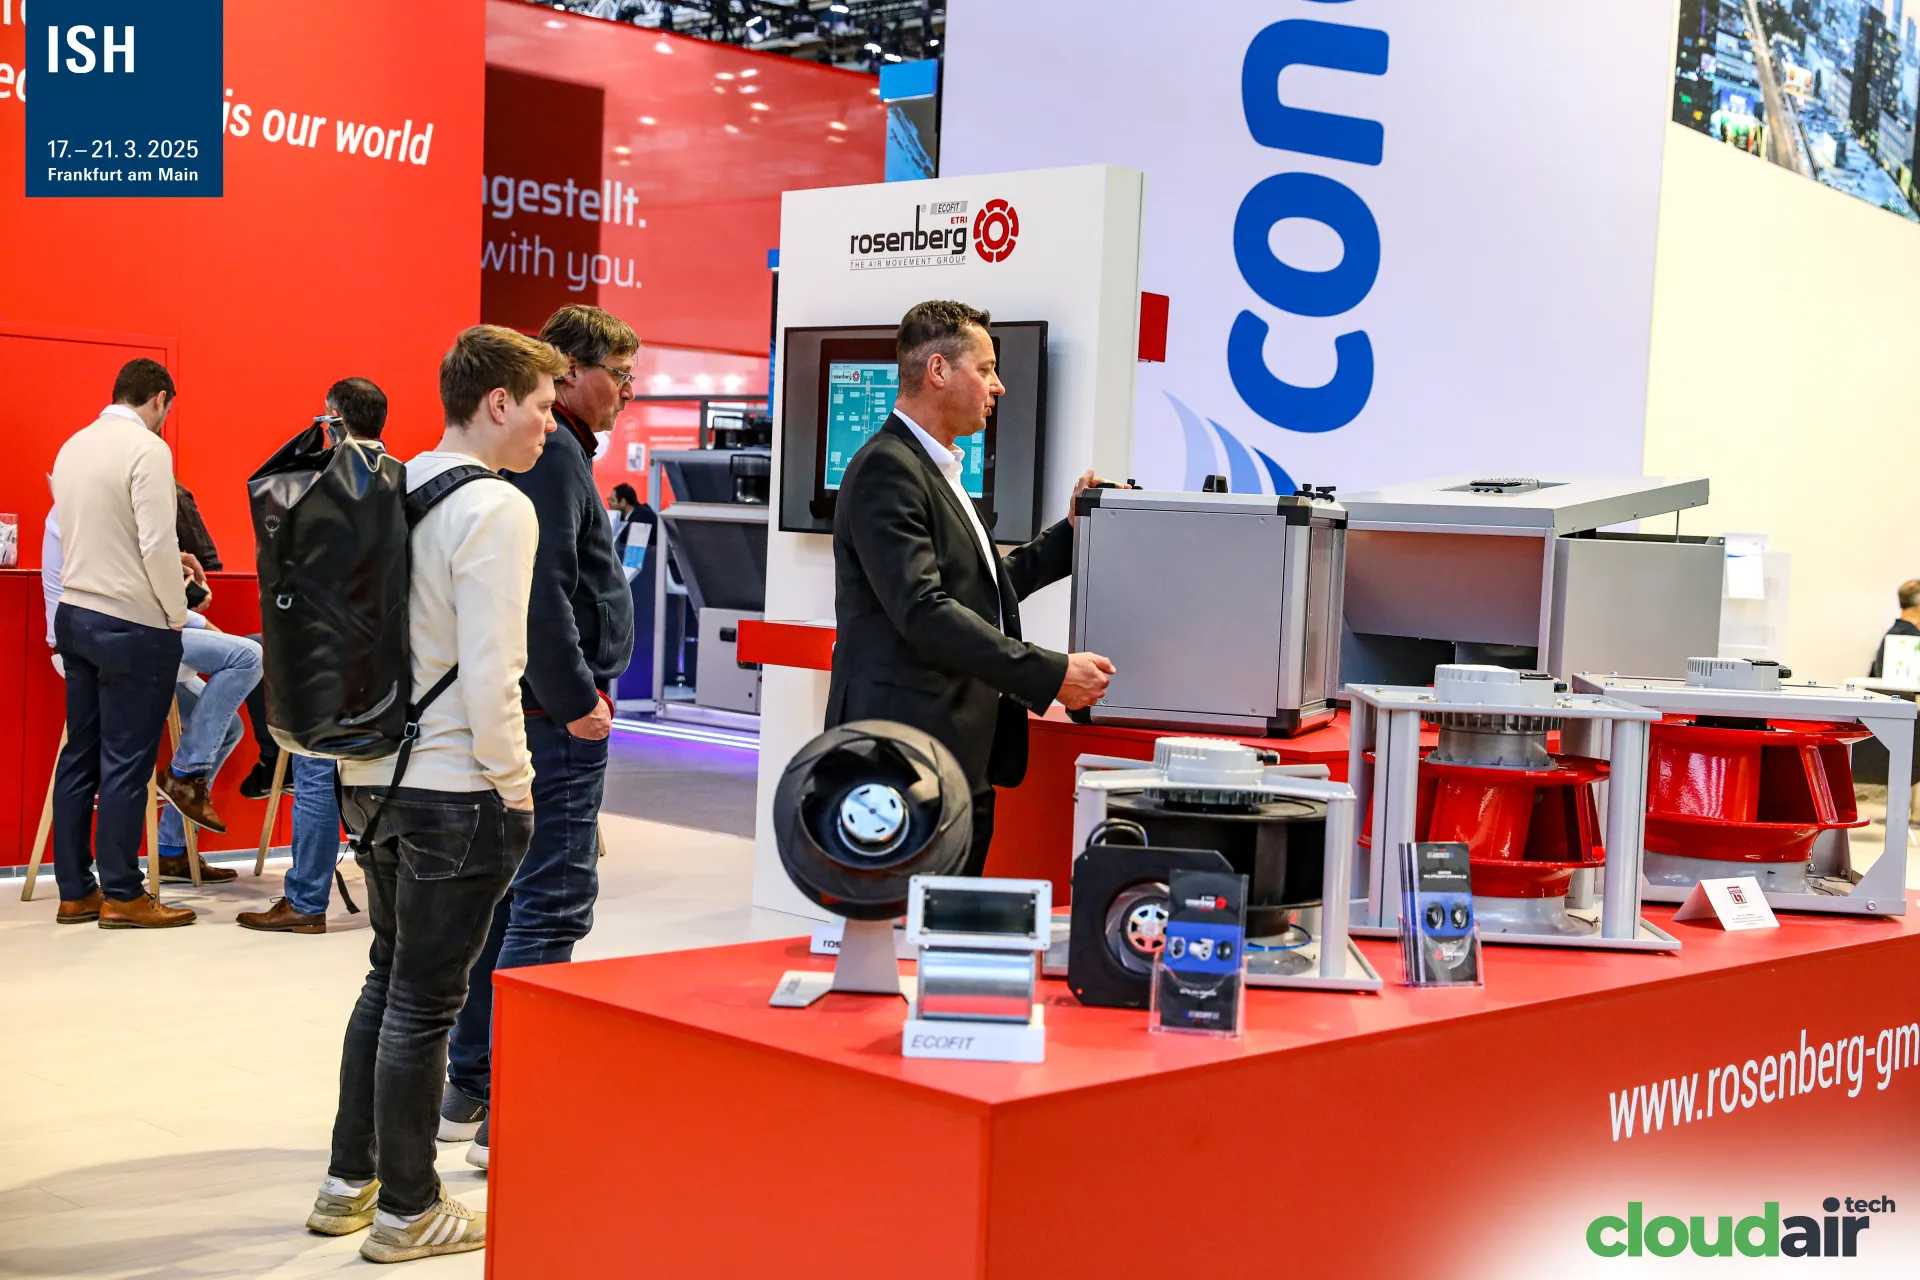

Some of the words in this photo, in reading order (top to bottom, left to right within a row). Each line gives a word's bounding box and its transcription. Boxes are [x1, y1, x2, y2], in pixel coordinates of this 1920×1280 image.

[223, 87, 252, 137] is
[262, 108, 328, 148] our
[335, 118, 435, 166] world
[937, 202, 960, 213] ECOFIT
[951, 216, 967, 224] ETRI
[1226, 0, 1391, 434] con
[851, 204, 967, 255] rosenberg
[566, 250, 643, 292] you.
[885, 258, 931, 267] MOVEMENT
[937, 256, 966, 264] GROUP
[910, 1033, 975, 1051] ECOFIT
[1609, 1022, 1920, 1142] www.rosenberg-gm
